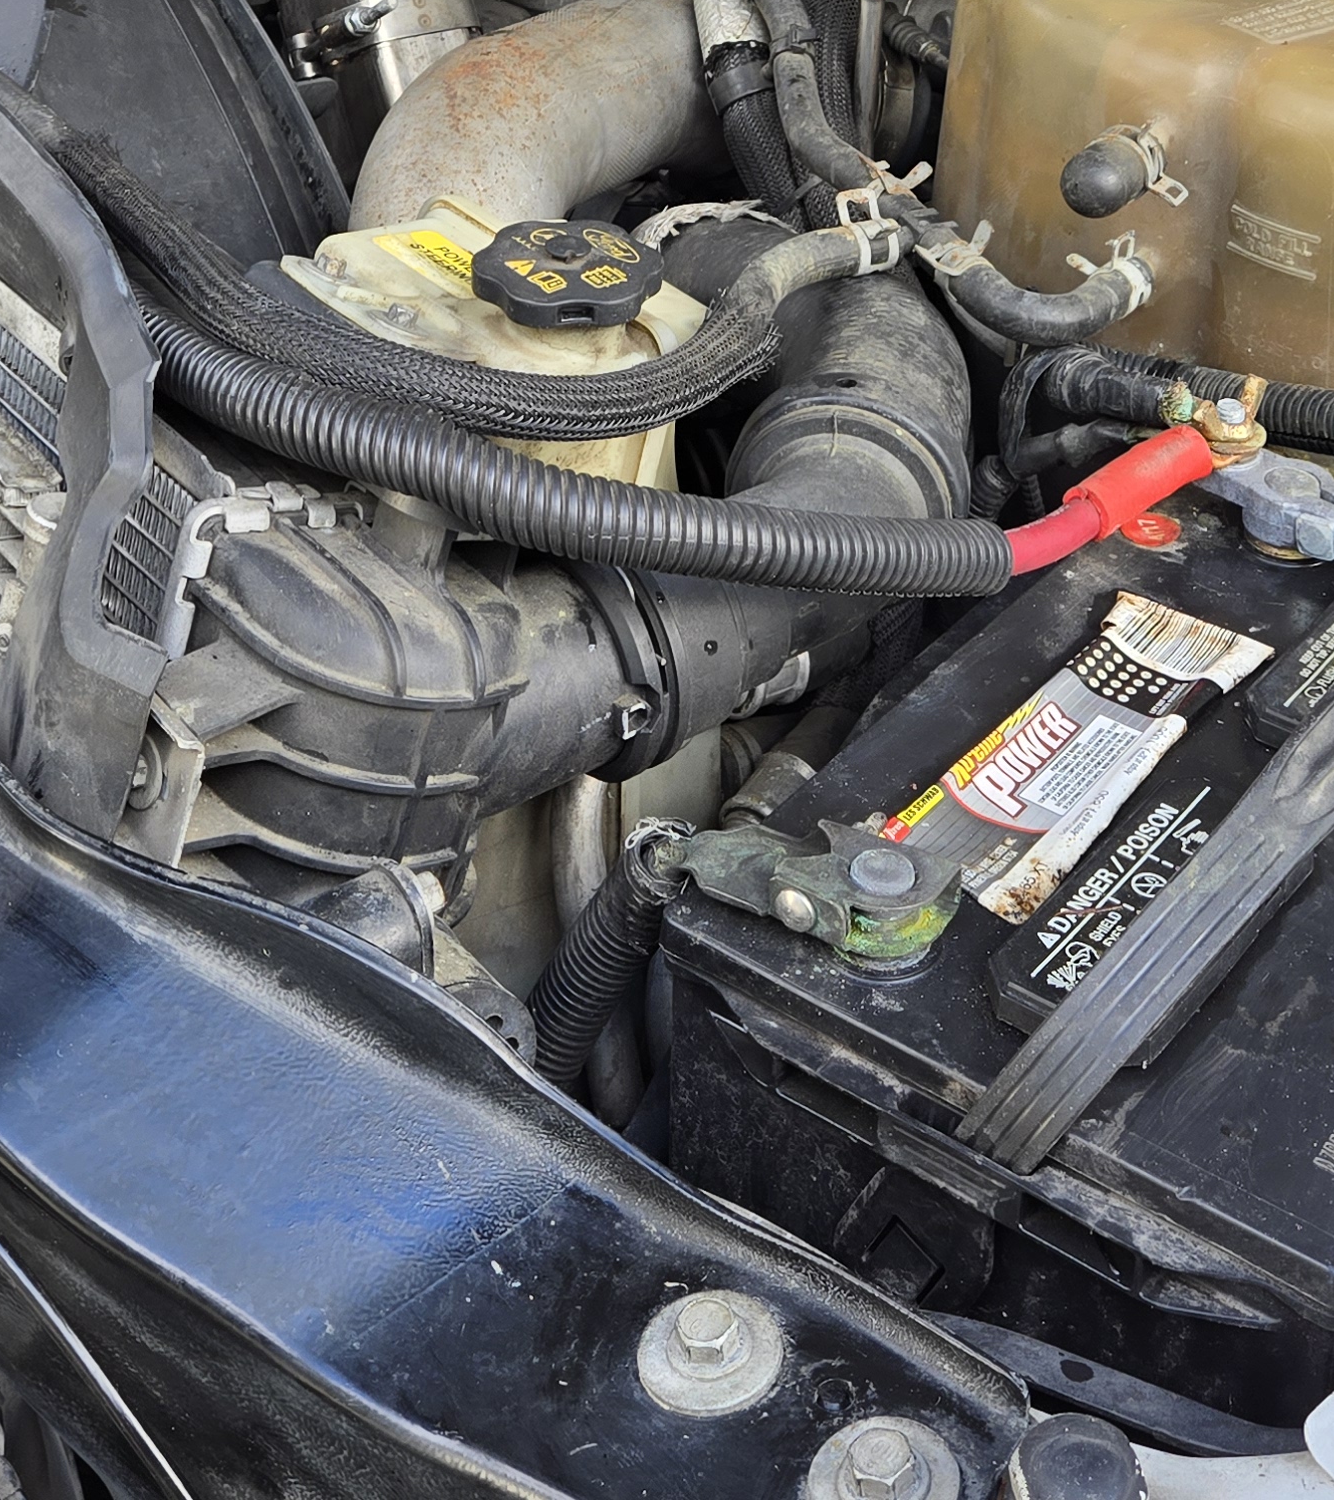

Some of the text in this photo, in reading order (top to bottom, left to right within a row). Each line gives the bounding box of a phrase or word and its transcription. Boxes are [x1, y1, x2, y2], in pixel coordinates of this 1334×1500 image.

[409, 243, 473, 284] STEERIN
[435, 246, 472, 273] POWE
[1246, 236, 1295, 265] RANGE
[1278, 234, 1313, 257] FILL
[974, 701, 1081, 819] POWER
[902, 785, 941, 822] LES SCHWAB
[1046, 864, 1120, 936] DANGER
[1115, 800, 1181, 862] POISON
[1087, 908, 1123, 943] SHIELD
